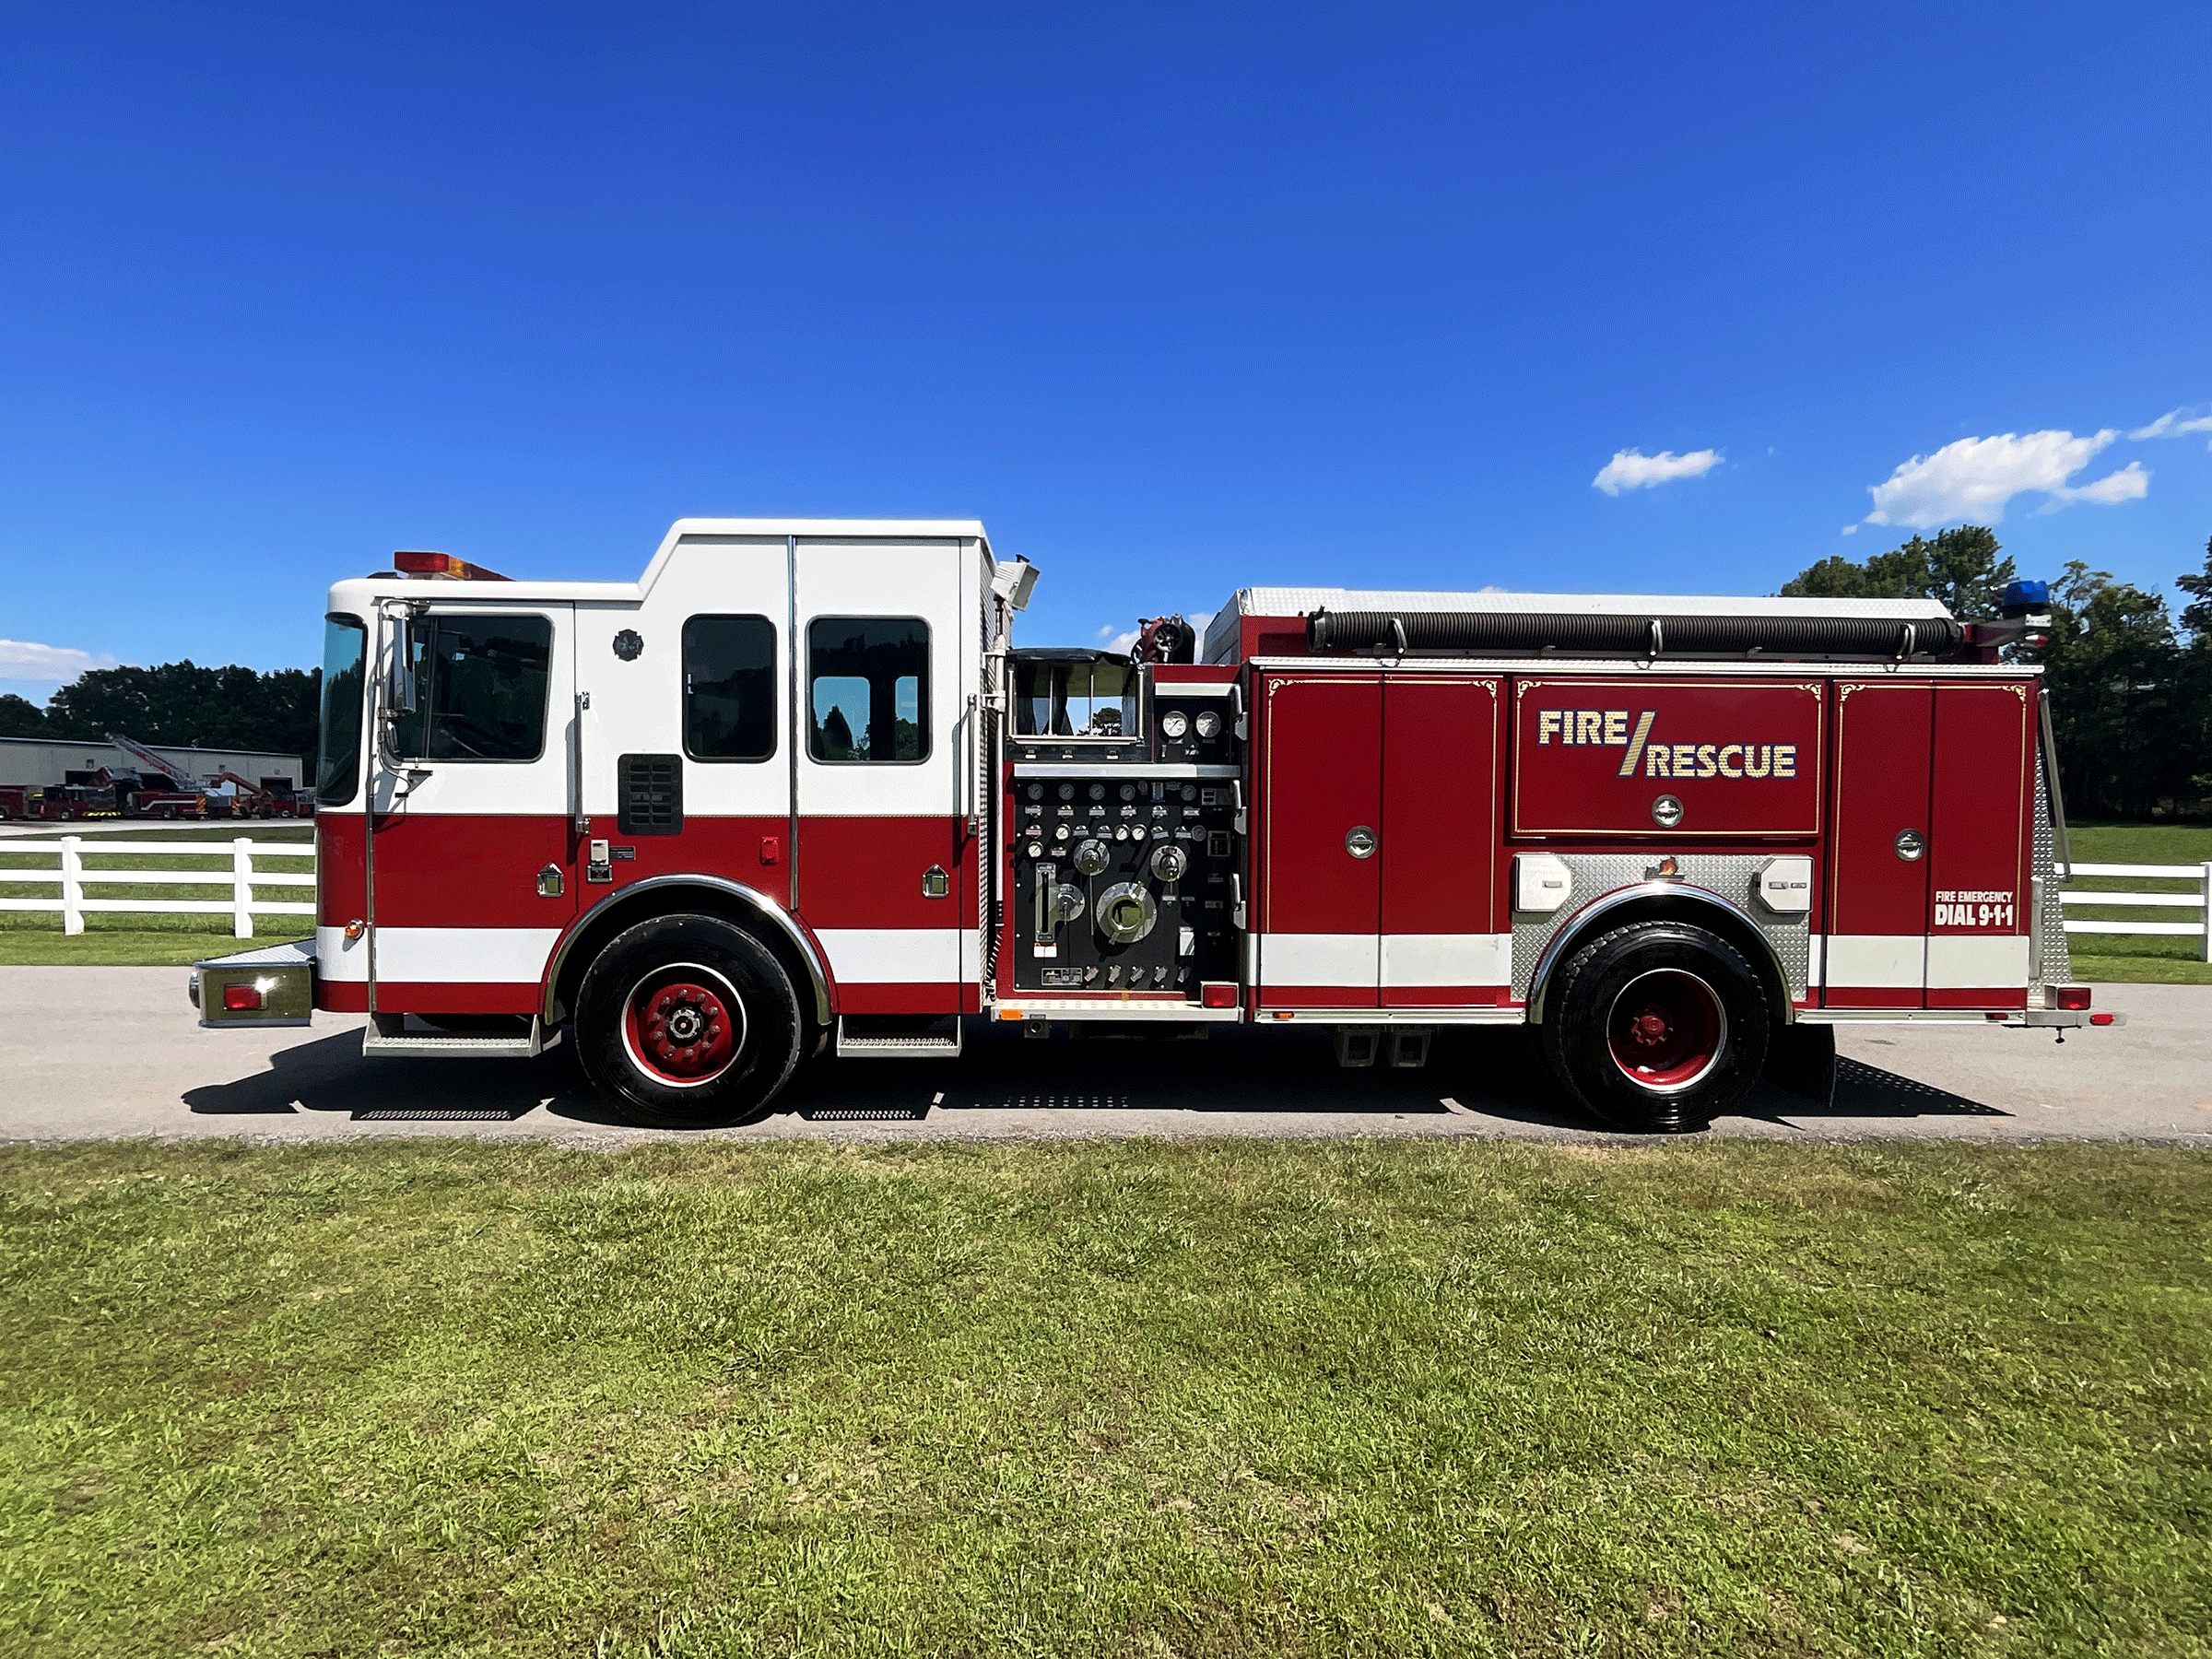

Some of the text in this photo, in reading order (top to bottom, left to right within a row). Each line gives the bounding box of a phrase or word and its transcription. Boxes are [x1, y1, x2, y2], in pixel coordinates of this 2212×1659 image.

[1645, 744, 1797, 778] RESCUE
[1936, 891, 2013, 902] FIRE EMERGENCY
[1935, 904, 1976, 925] DIAL
